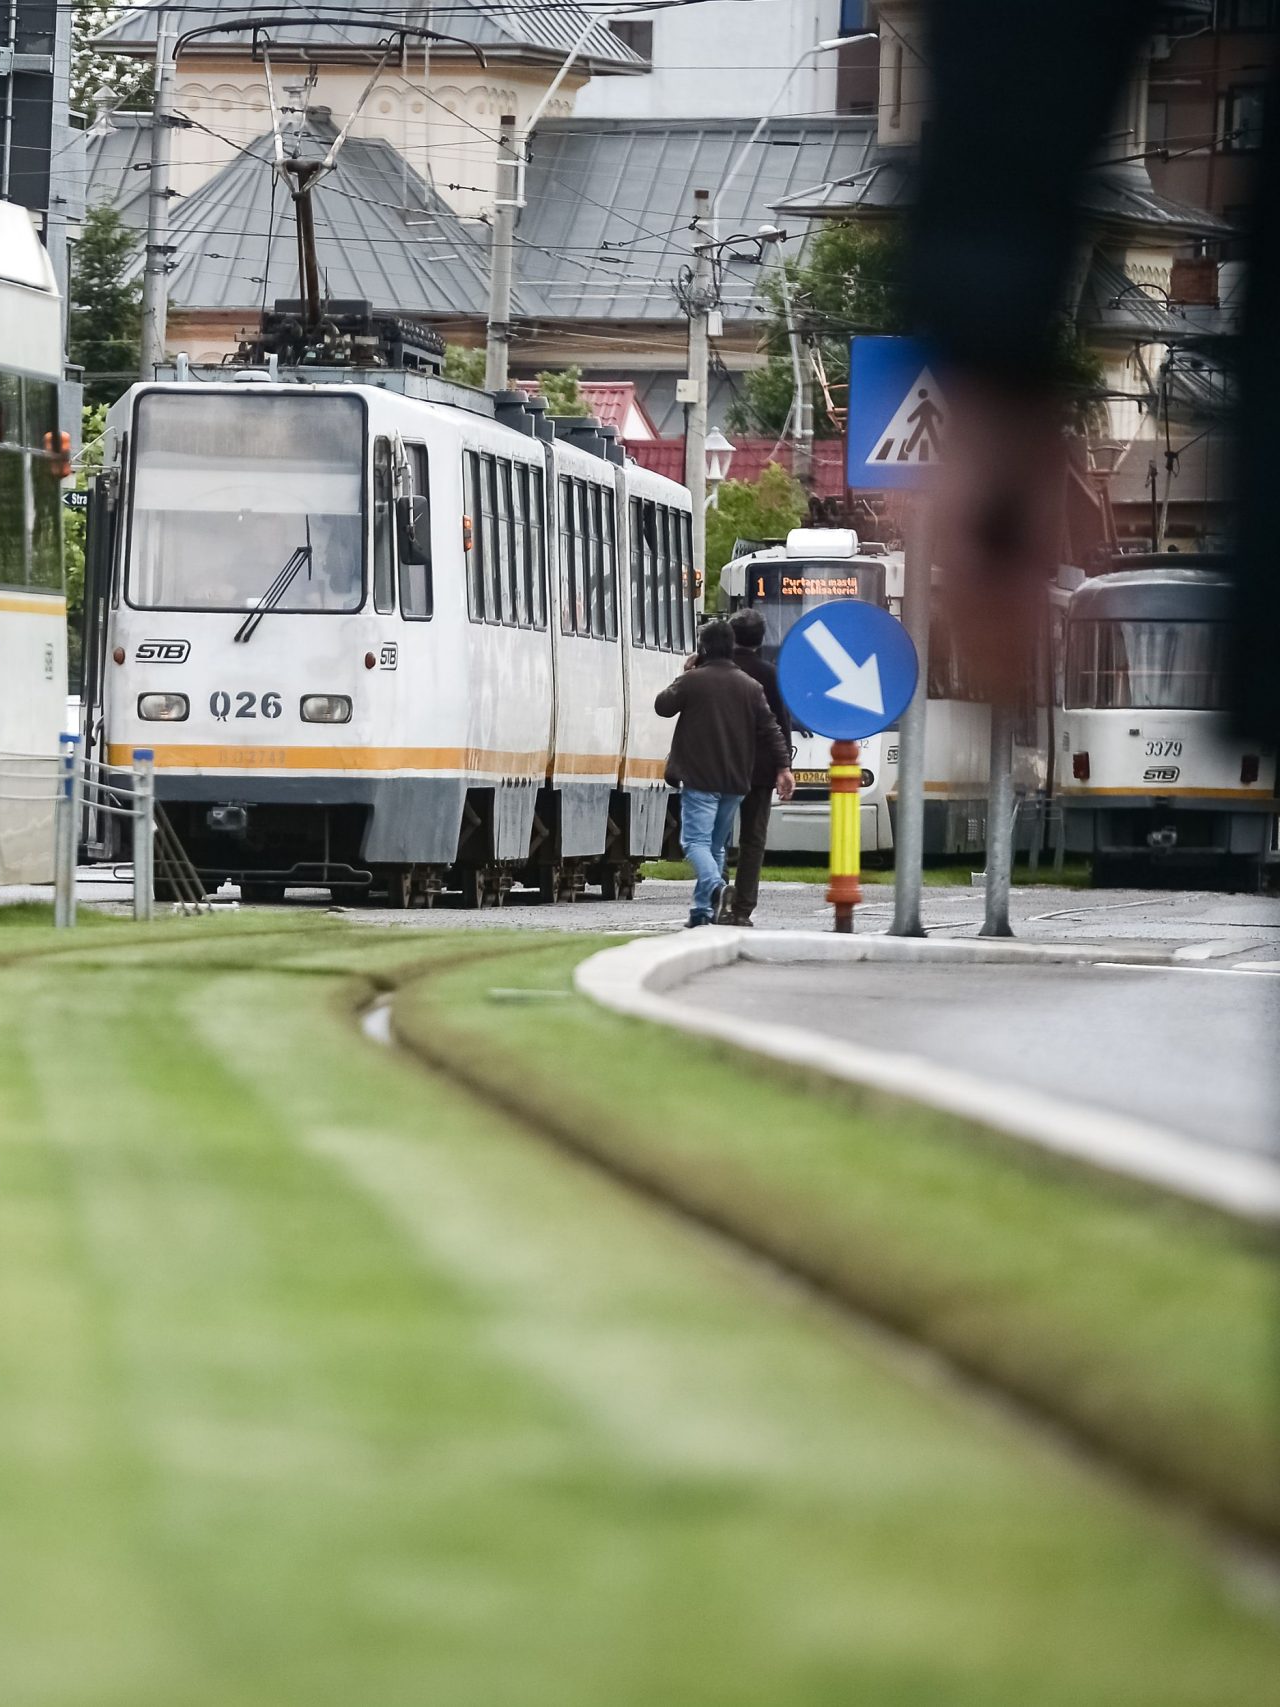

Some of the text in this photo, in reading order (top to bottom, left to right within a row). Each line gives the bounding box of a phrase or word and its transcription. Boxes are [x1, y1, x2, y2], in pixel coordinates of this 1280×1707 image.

[757, 577, 765, 596] 1
[782, 586, 803, 595] este
[135, 642, 187, 660] STB
[380, 646, 397, 666] STB
[1145, 741, 1182, 756] 3379
[1143, 768, 1177, 781] STB
